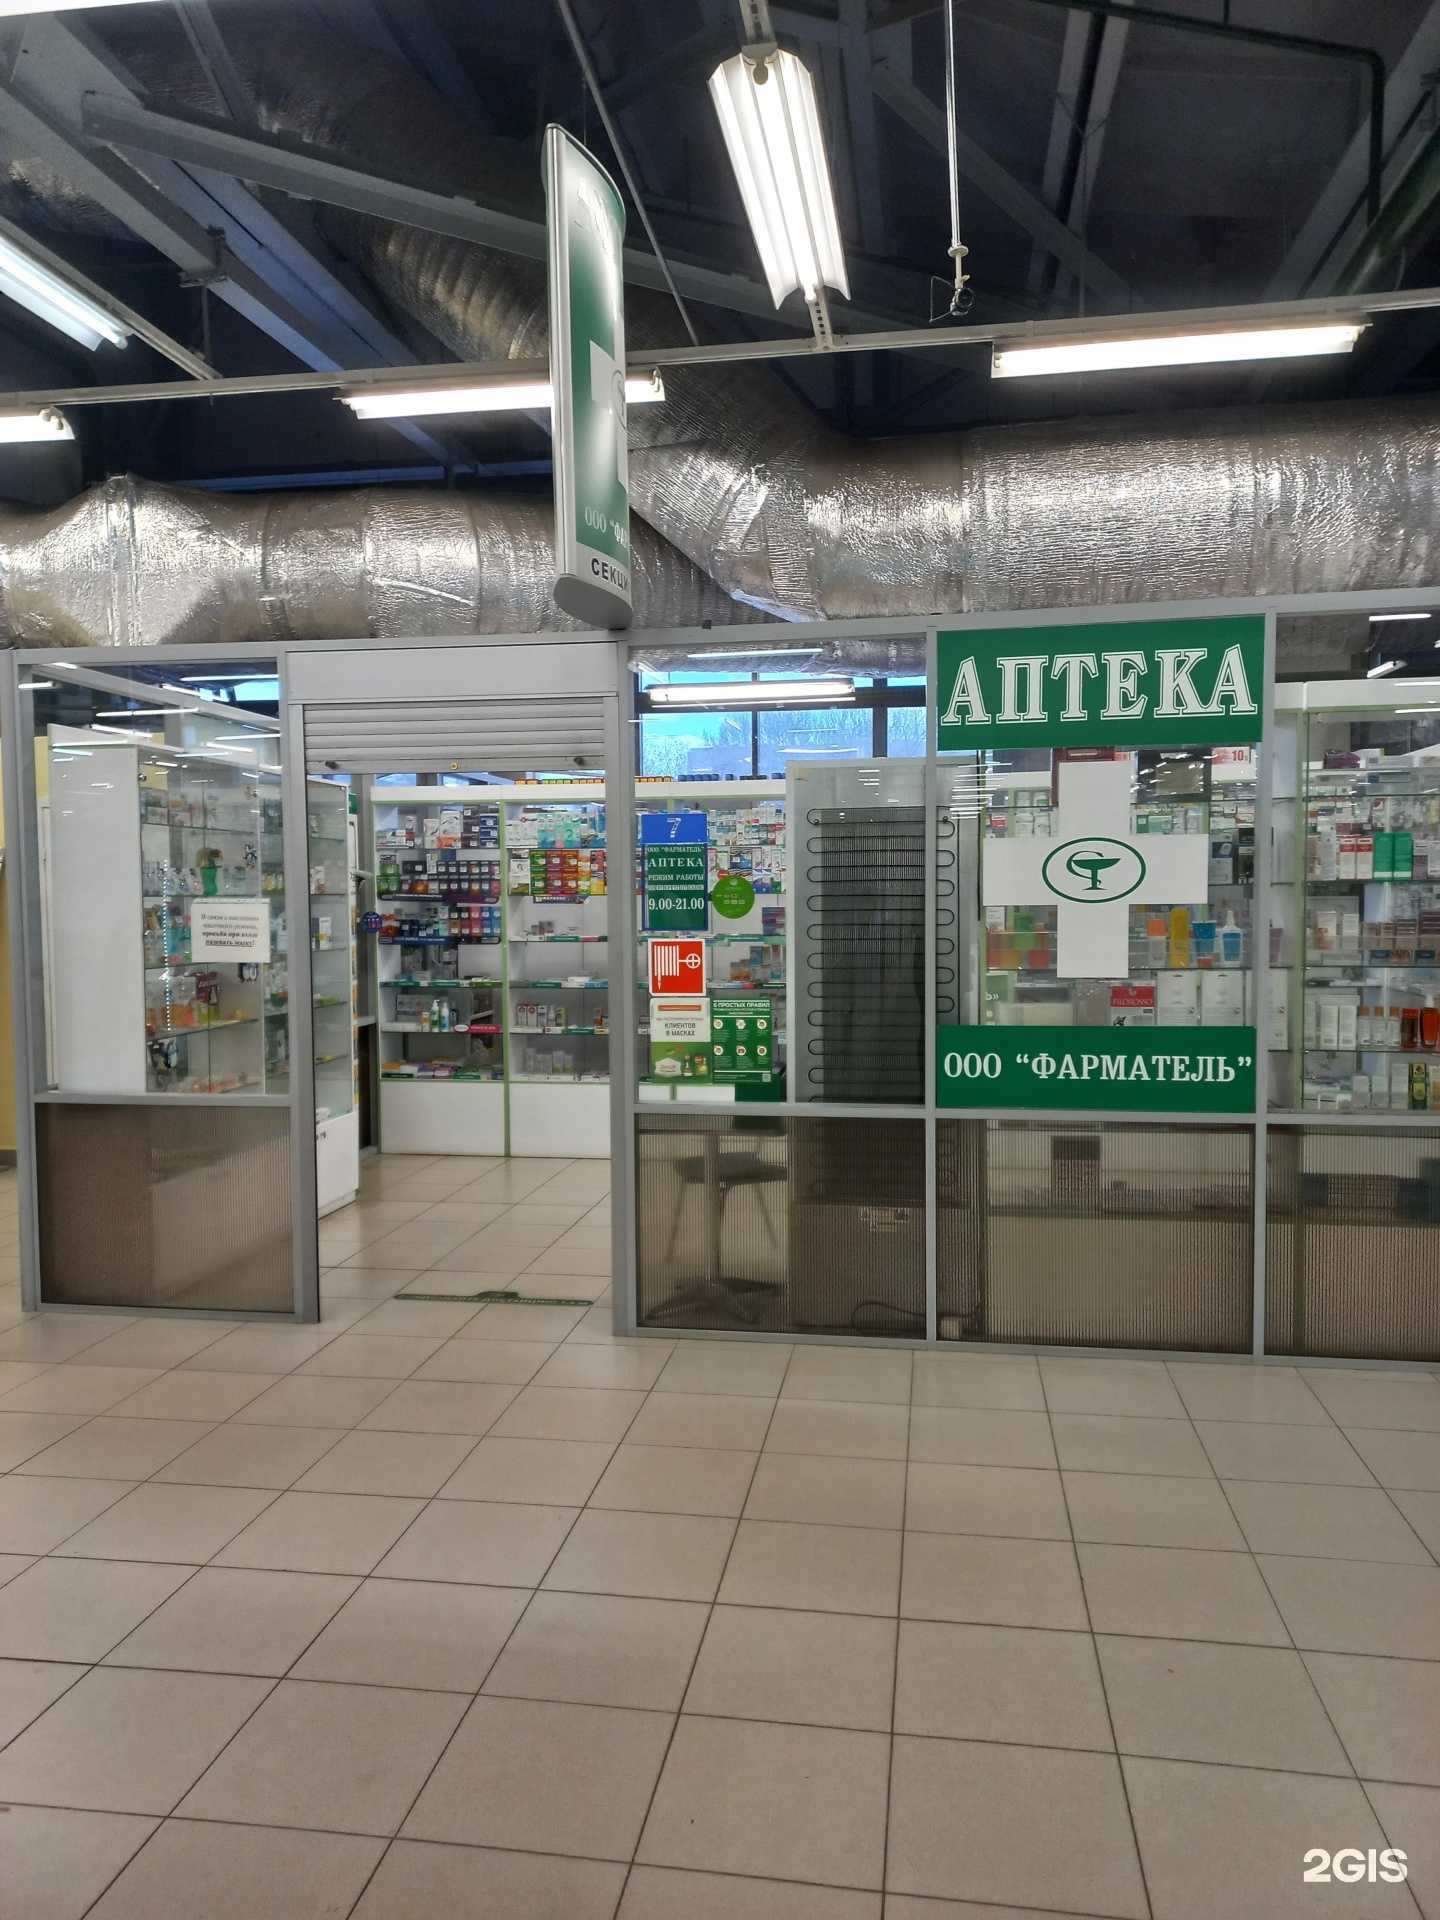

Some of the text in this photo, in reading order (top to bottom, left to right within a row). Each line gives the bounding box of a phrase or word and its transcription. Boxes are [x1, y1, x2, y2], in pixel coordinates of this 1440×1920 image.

[940, 643, 1258, 726] АПТЕКА
[666, 817, 682, 838] 7
[648, 858, 704, 867] АПТЕКА
[648, 898, 705, 910] 9.00-21.00
[944, 1052, 1253, 1083] ООО “ФАРМАТЕЛЬ”
